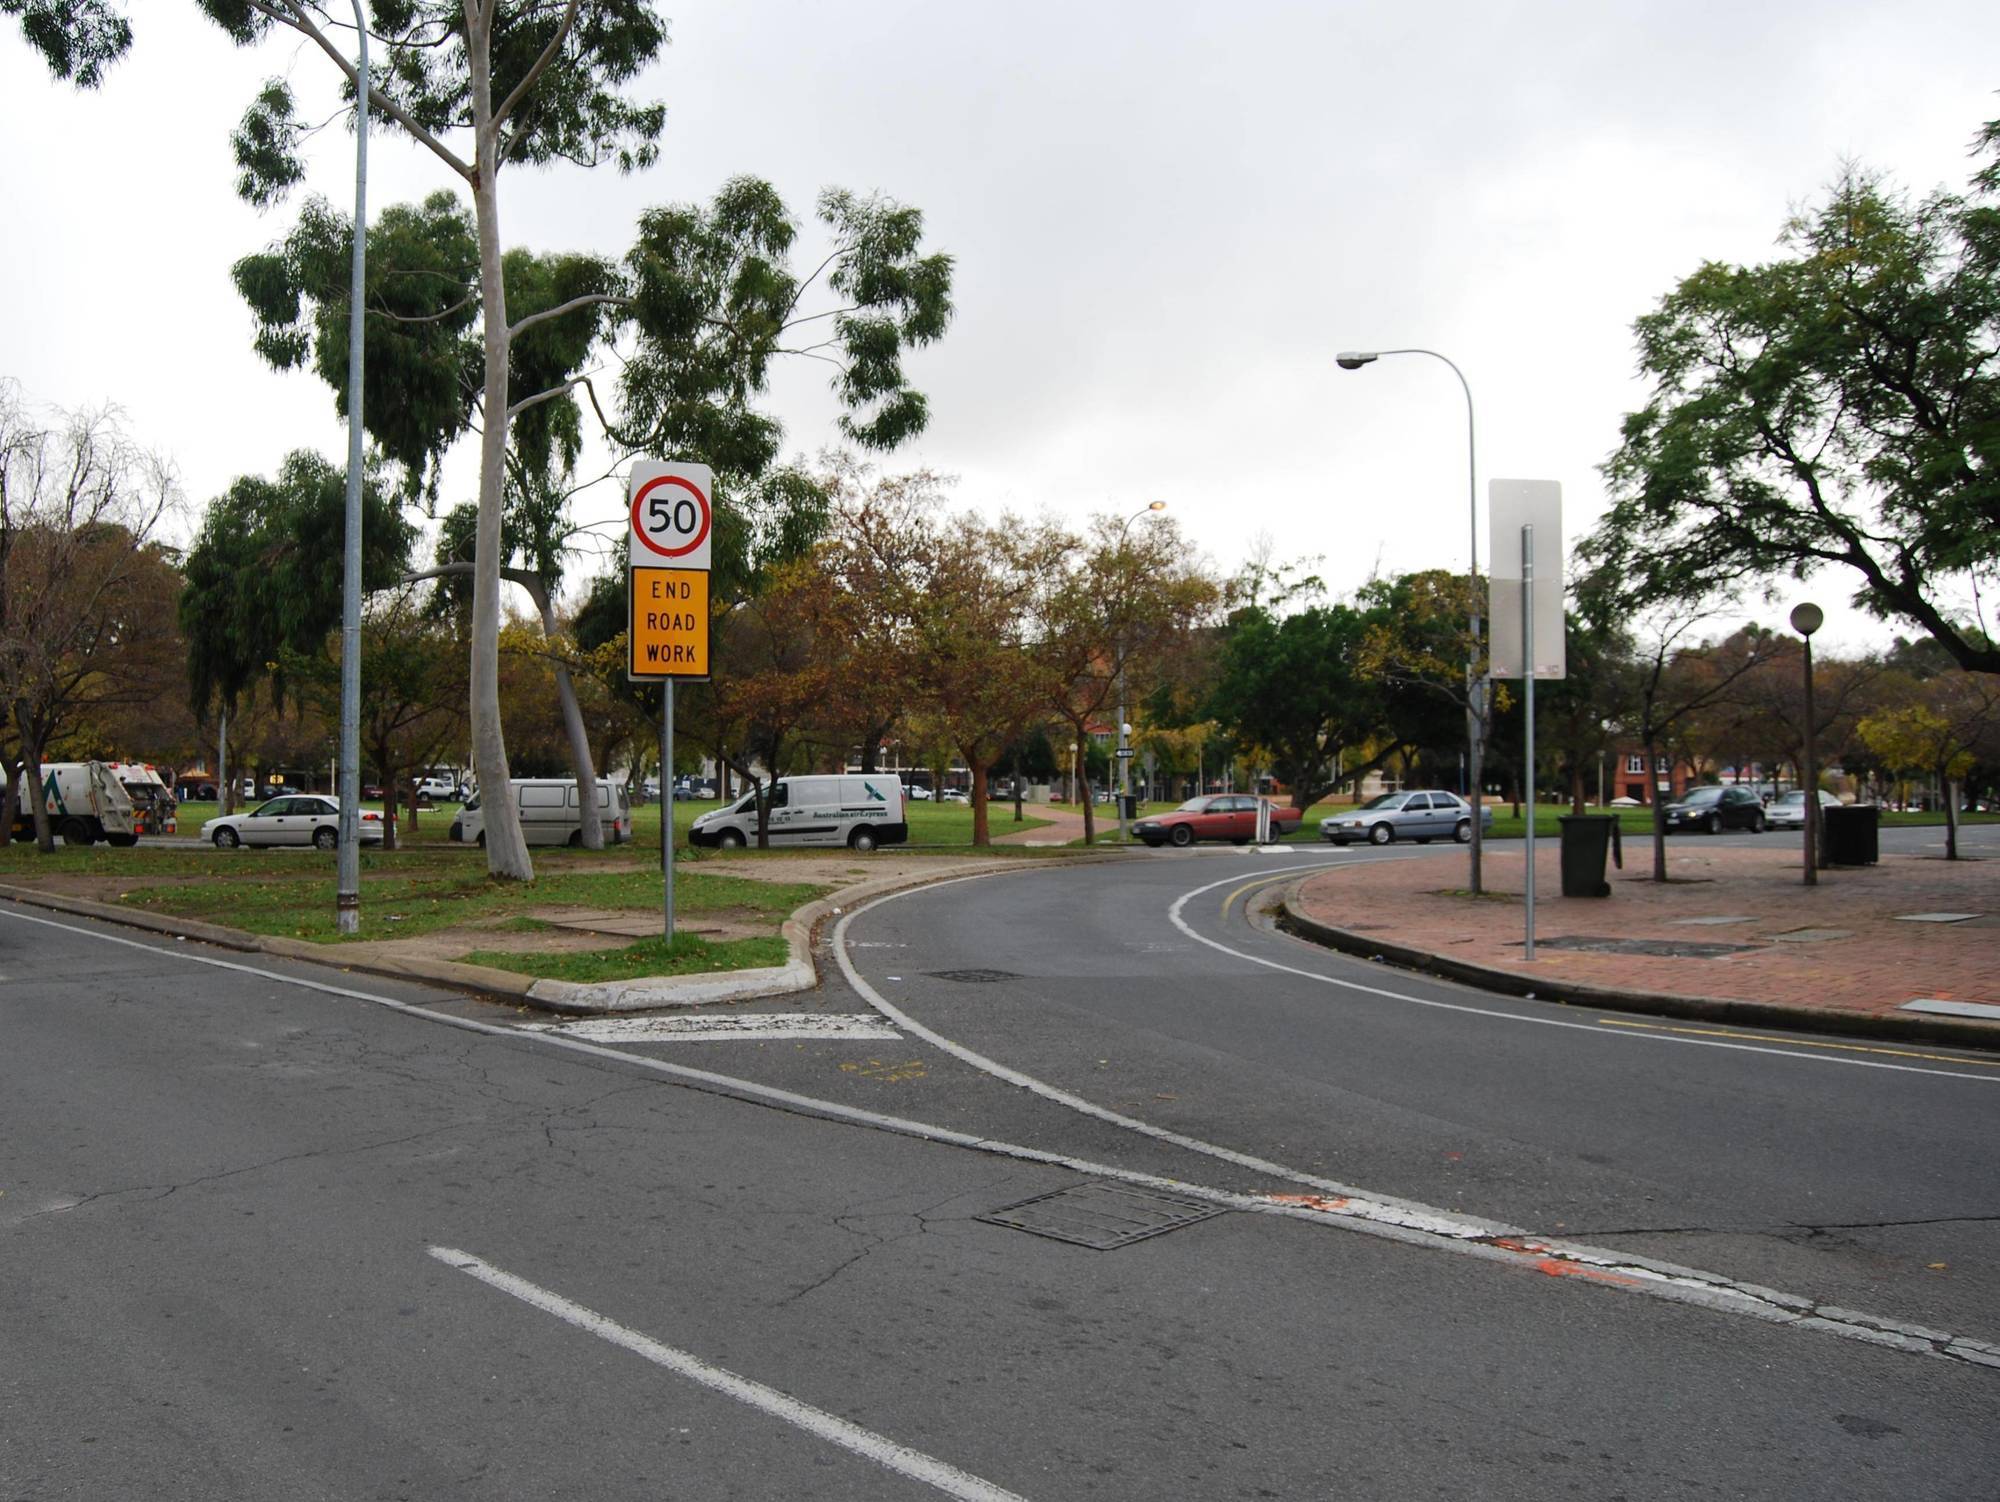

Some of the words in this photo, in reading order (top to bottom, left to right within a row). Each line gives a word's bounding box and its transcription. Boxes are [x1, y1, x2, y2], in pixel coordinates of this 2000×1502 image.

[648, 498, 696, 534] 50
[652, 581, 690, 600] END
[647, 612, 695, 631] ROAD
[647, 644, 696, 663] WORK
